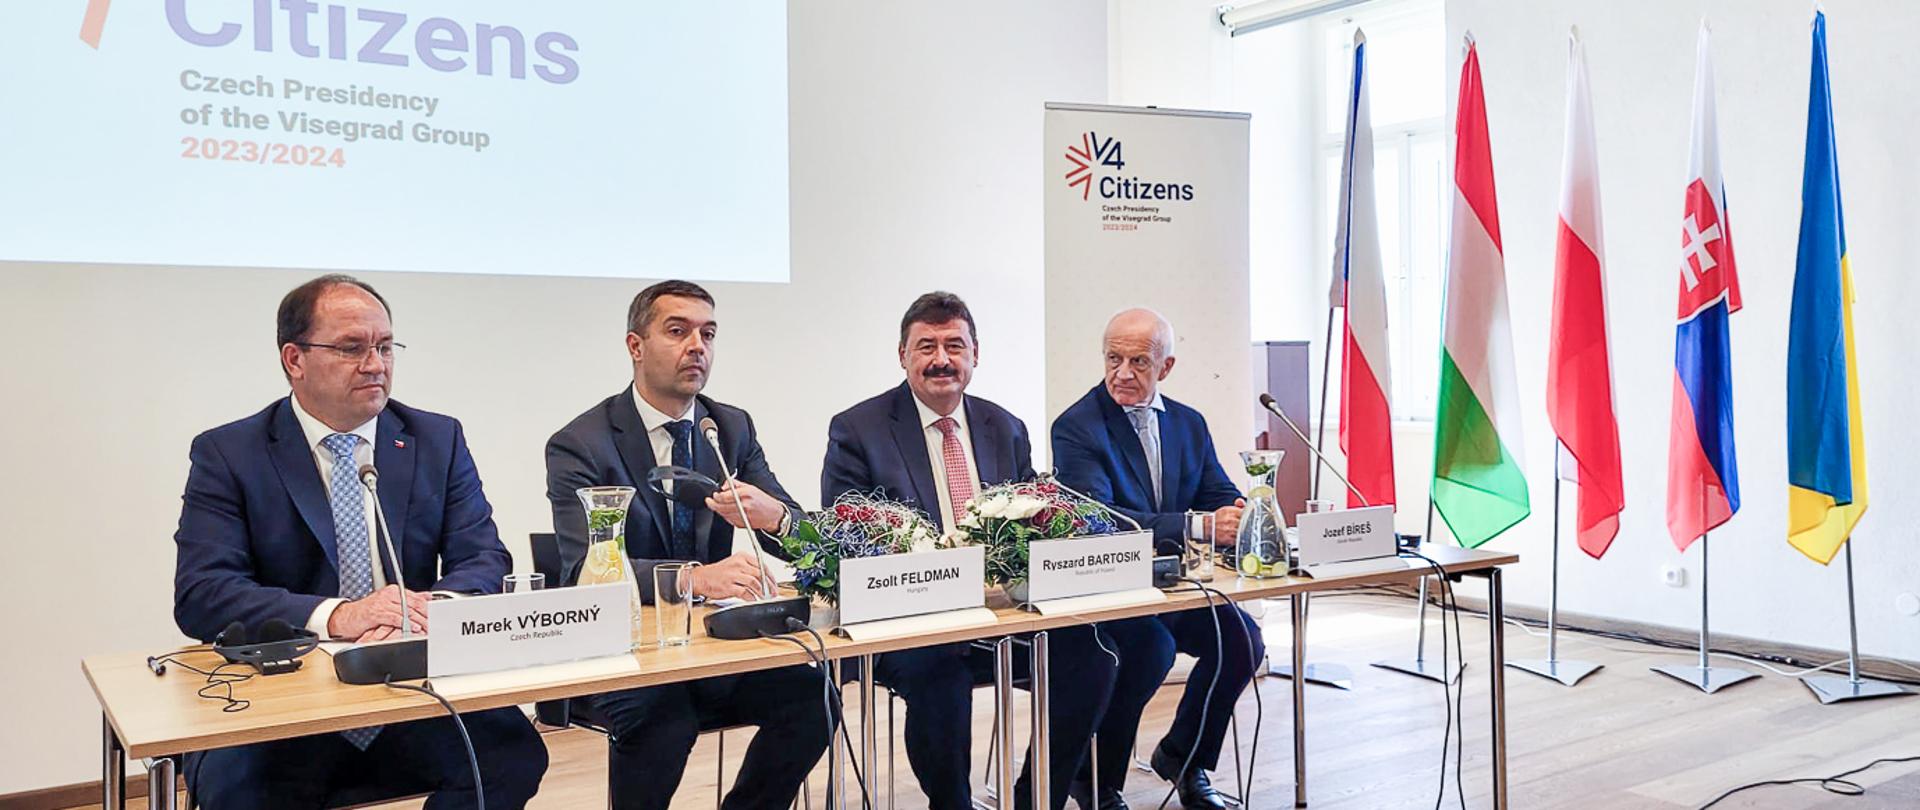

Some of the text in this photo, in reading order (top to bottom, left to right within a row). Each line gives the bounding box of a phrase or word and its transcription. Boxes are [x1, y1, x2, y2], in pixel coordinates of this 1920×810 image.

[179, 69, 439, 117] Czech Presidency
[180, 104, 491, 152] of the Visegrad Group
[180, 136, 346, 168] 2023/2024
[1091, 131, 1125, 170] V4
[1100, 176, 1194, 200] Citizens
[1122, 215, 1151, 223] Visegrad
[1123, 205, 1159, 214] Presidency
[1323, 527, 1345, 538] Jozef
[1087, 550, 1141, 566] BARTOSIK
[867, 567, 960, 590] Zsolt FELDMAN
[461, 604, 601, 635] Marek VÝBORNÝ
[510, 629, 563, 641] Czech Republic
